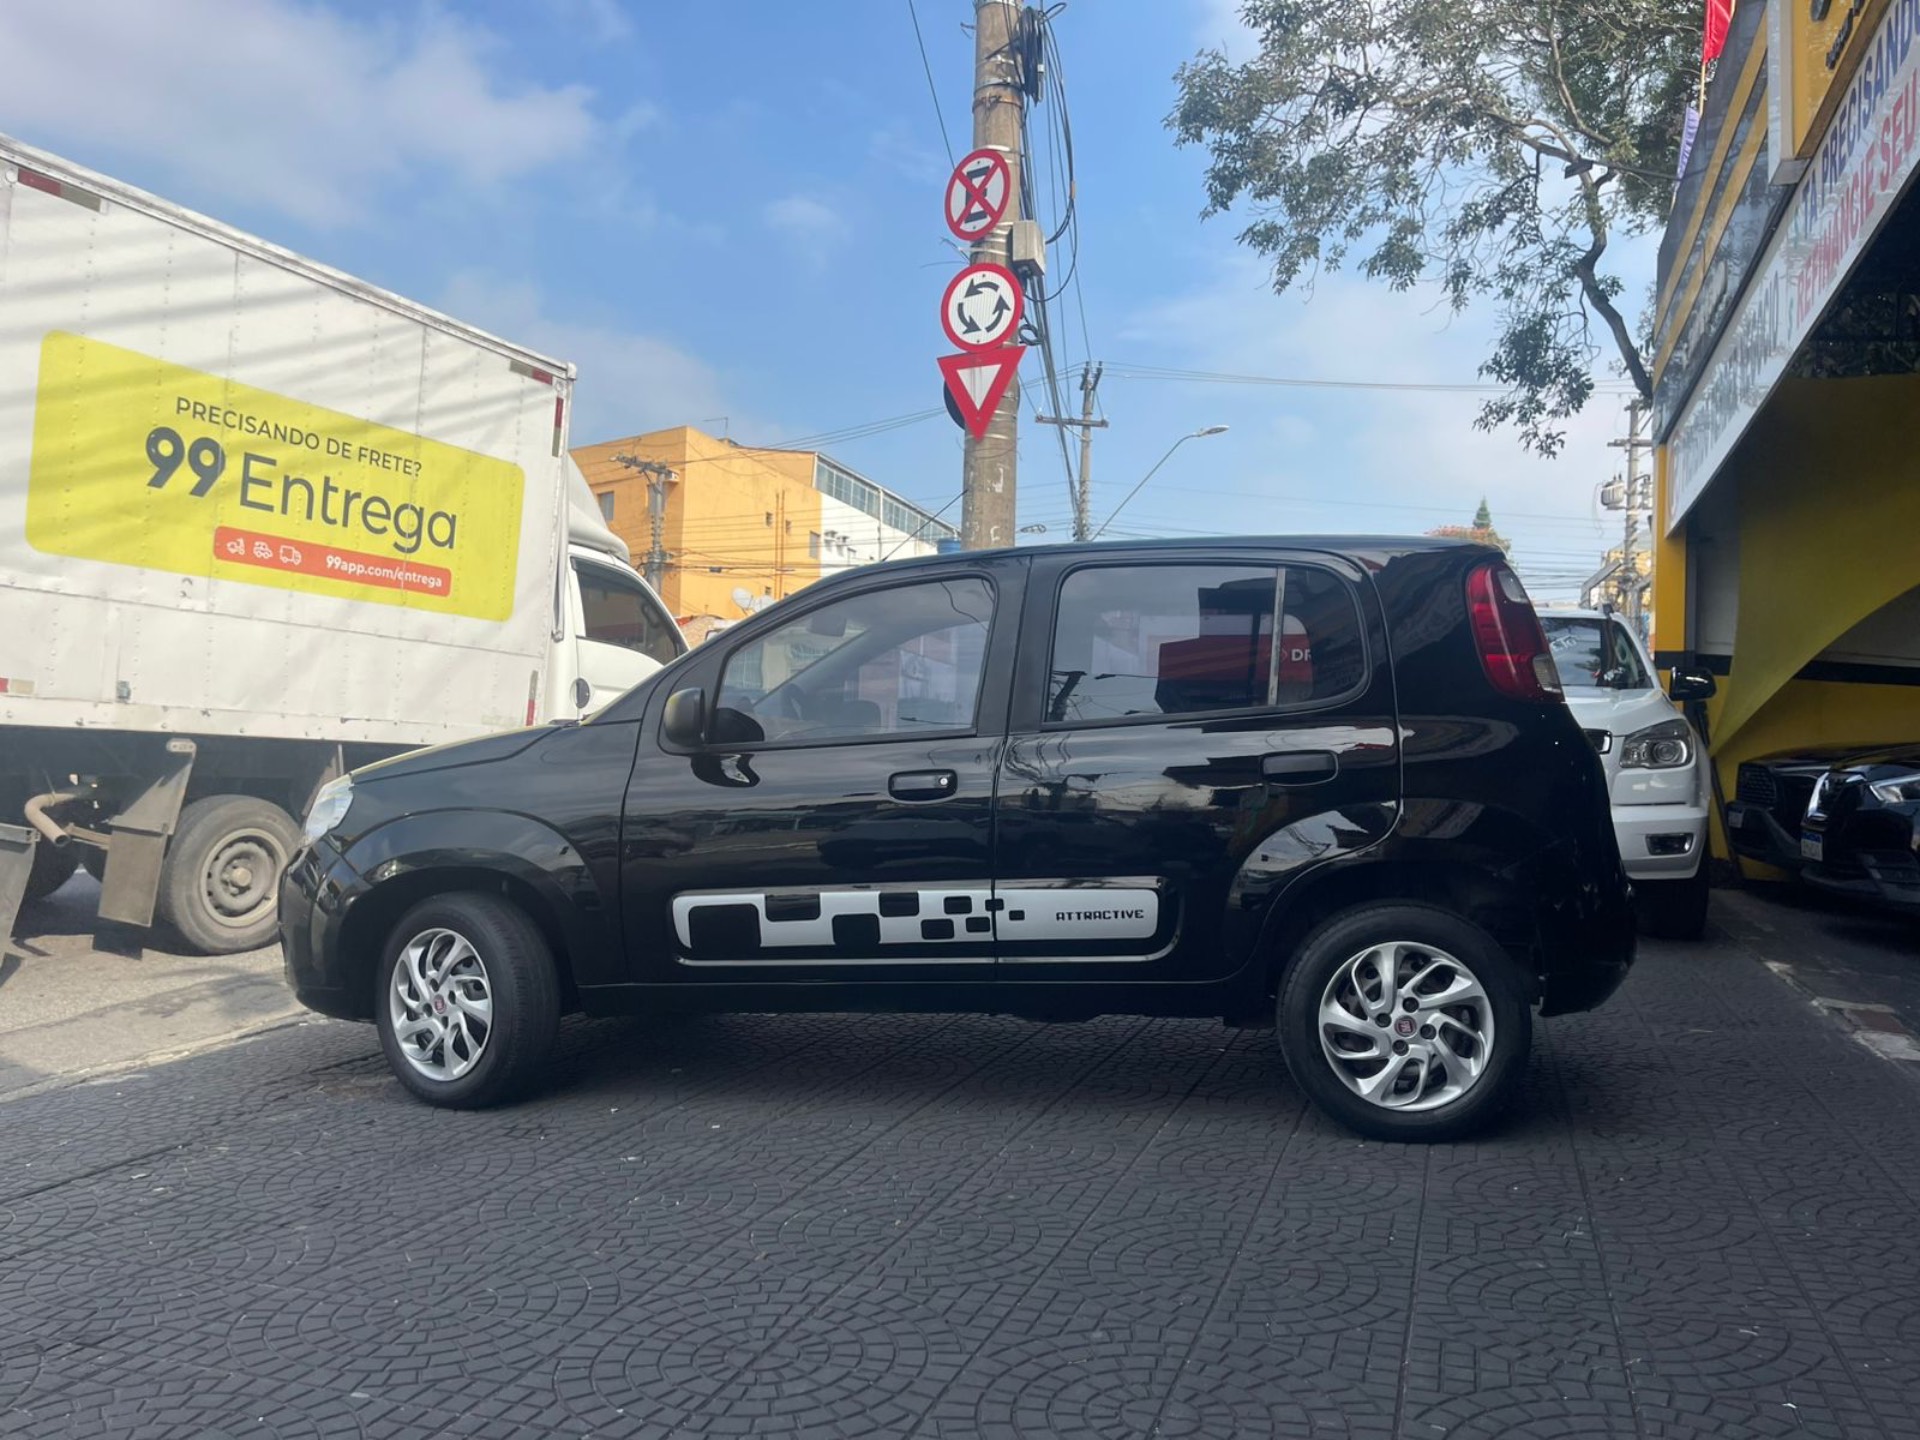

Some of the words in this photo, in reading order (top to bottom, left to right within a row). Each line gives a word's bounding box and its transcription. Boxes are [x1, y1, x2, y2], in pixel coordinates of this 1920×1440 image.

[1880, 67, 1918, 193] SEU
[176, 396, 321, 451] PRECISANDO
[326, 437, 352, 460] DE
[358, 446, 423, 478] FRETE?
[145, 426, 226, 498] 99
[239, 451, 457, 554] Entrega
[325, 554, 443, 589] 99app.com/entrega
[1055, 909, 1145, 921] ATTRACTIVE
